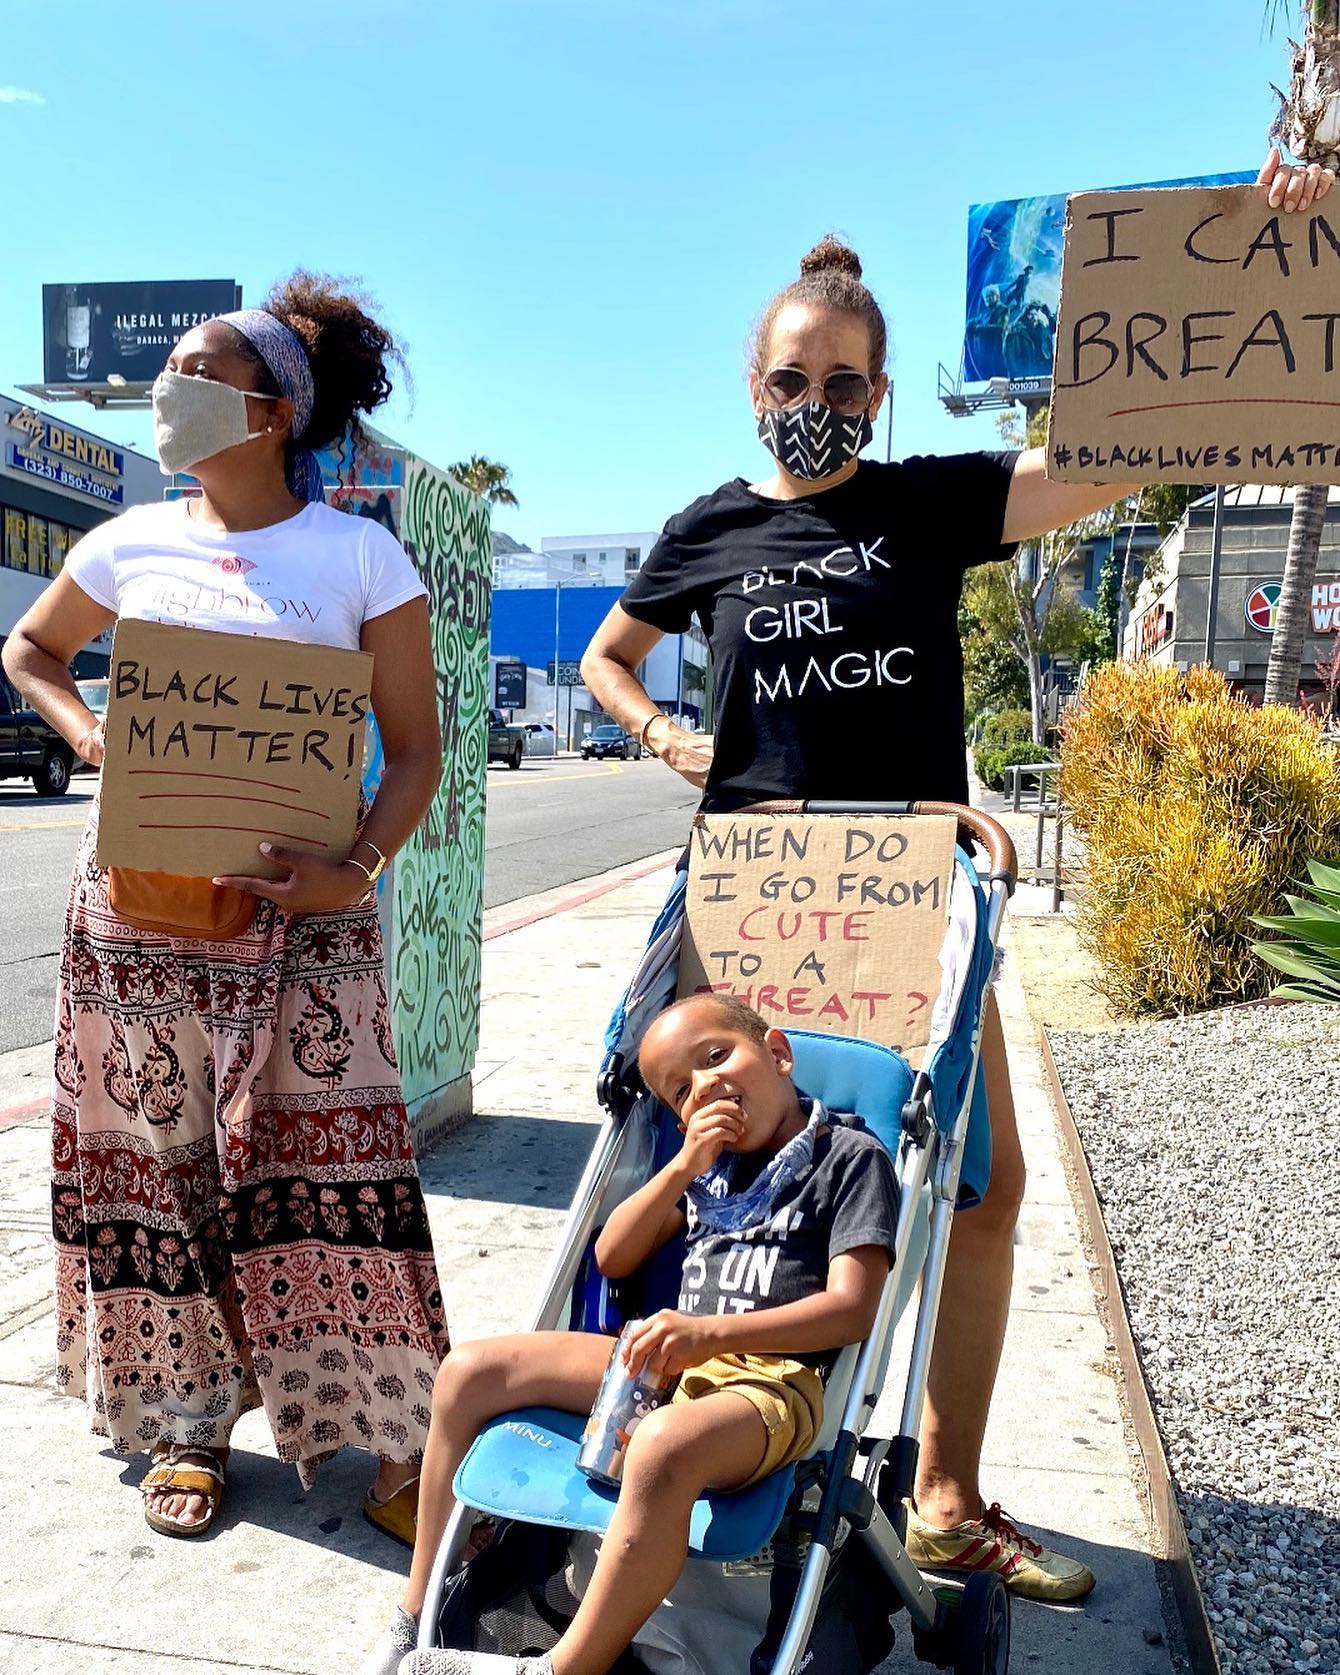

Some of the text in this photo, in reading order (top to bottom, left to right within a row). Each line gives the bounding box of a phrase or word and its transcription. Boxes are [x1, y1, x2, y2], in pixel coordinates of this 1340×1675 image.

[1082, 208, 1144, 268] I
[116, 313, 164, 328] ILEGAL
[51, 426, 119, 475] DENTAL
[24, 458, 57, 480] (323)
[60, 471, 114, 500] 850-7007
[742, 536, 891, 594] BLACK
[744, 597, 843, 642] GIRL
[558, 666, 582, 676] COIN
[754, 647, 914, 704] MAGIC
[115, 661, 368, 724] BLACK LIVES
[127, 715, 355, 781] MATTER!
[696, 822, 909, 863] WHEN DO
[700, 871, 940, 910] I GO FROM
[738, 906, 876, 942] CUTE
[709, 950, 826, 985] TO A
[501, 1421, 552, 1448] MINU
